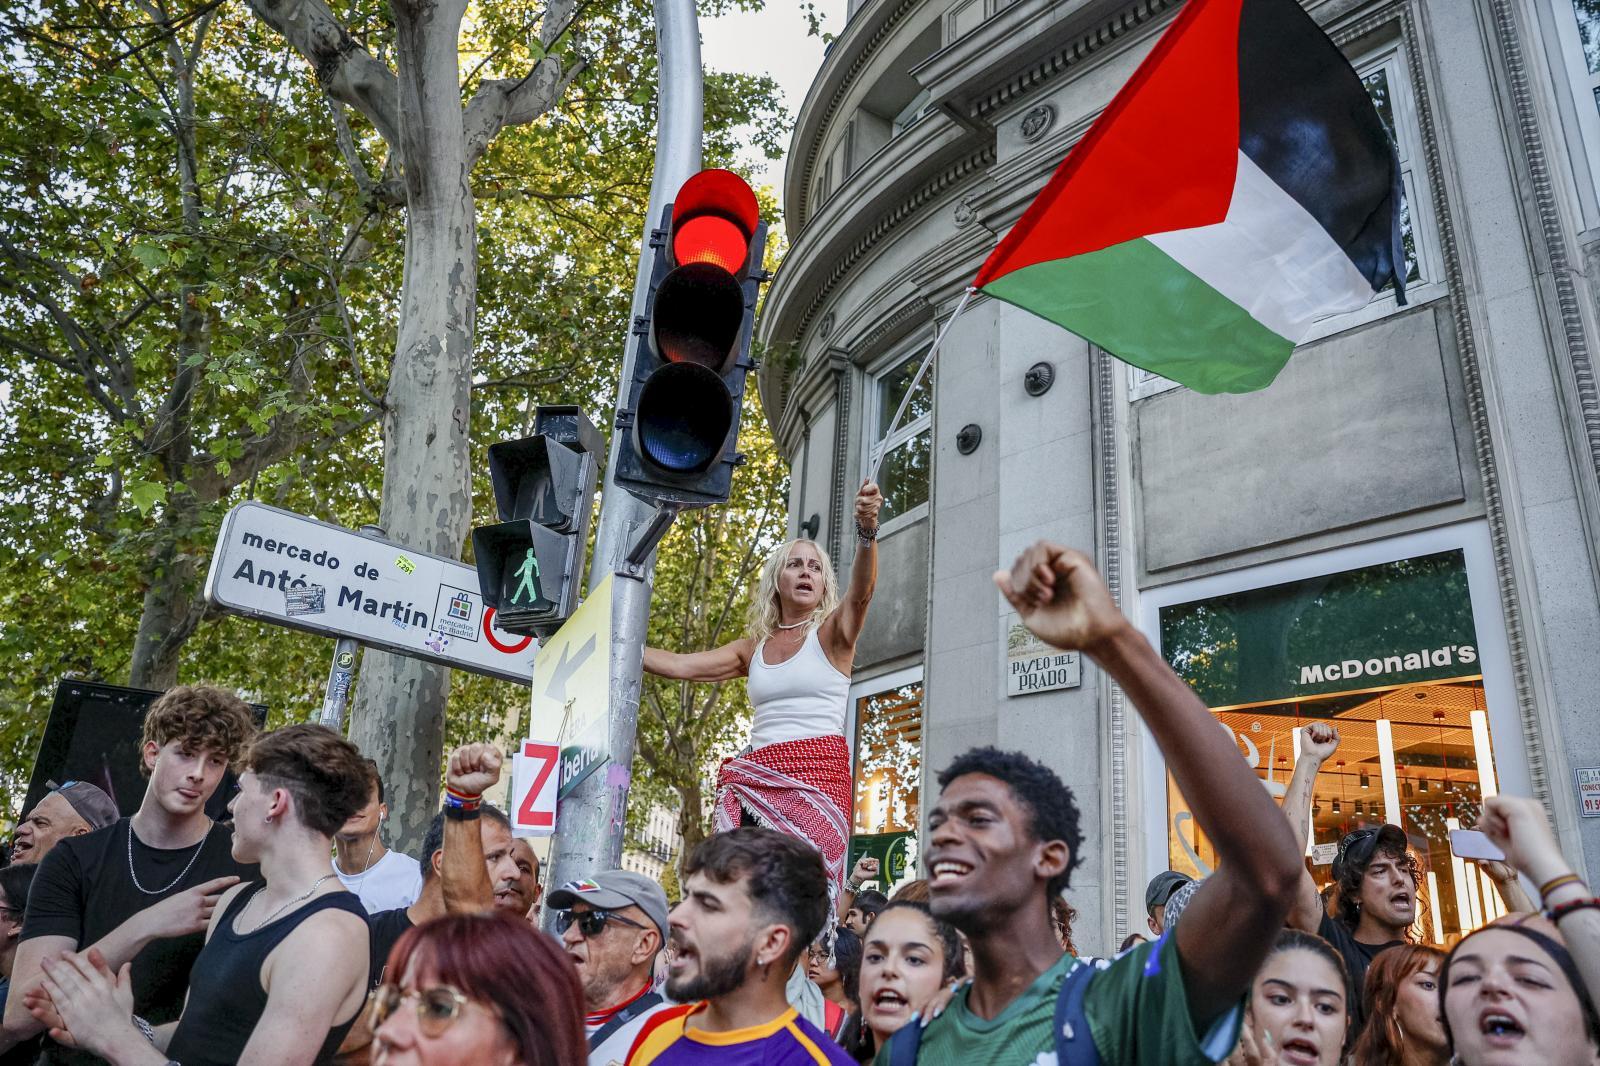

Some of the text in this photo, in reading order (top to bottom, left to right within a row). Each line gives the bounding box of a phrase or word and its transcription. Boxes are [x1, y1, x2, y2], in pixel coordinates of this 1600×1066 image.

[241, 531, 340, 570] mercado
[354, 561, 380, 582] de
[232, 558, 321, 593] Antó
[337, 585, 428, 629] Martín
[437, 623, 474, 638] de madrid
[440, 618, 474, 632] mercados
[1012, 654, 1074, 675] PASEO DEL
[1300, 645, 1477, 685] McDonald's
[1019, 668, 1067, 691] PRADO
